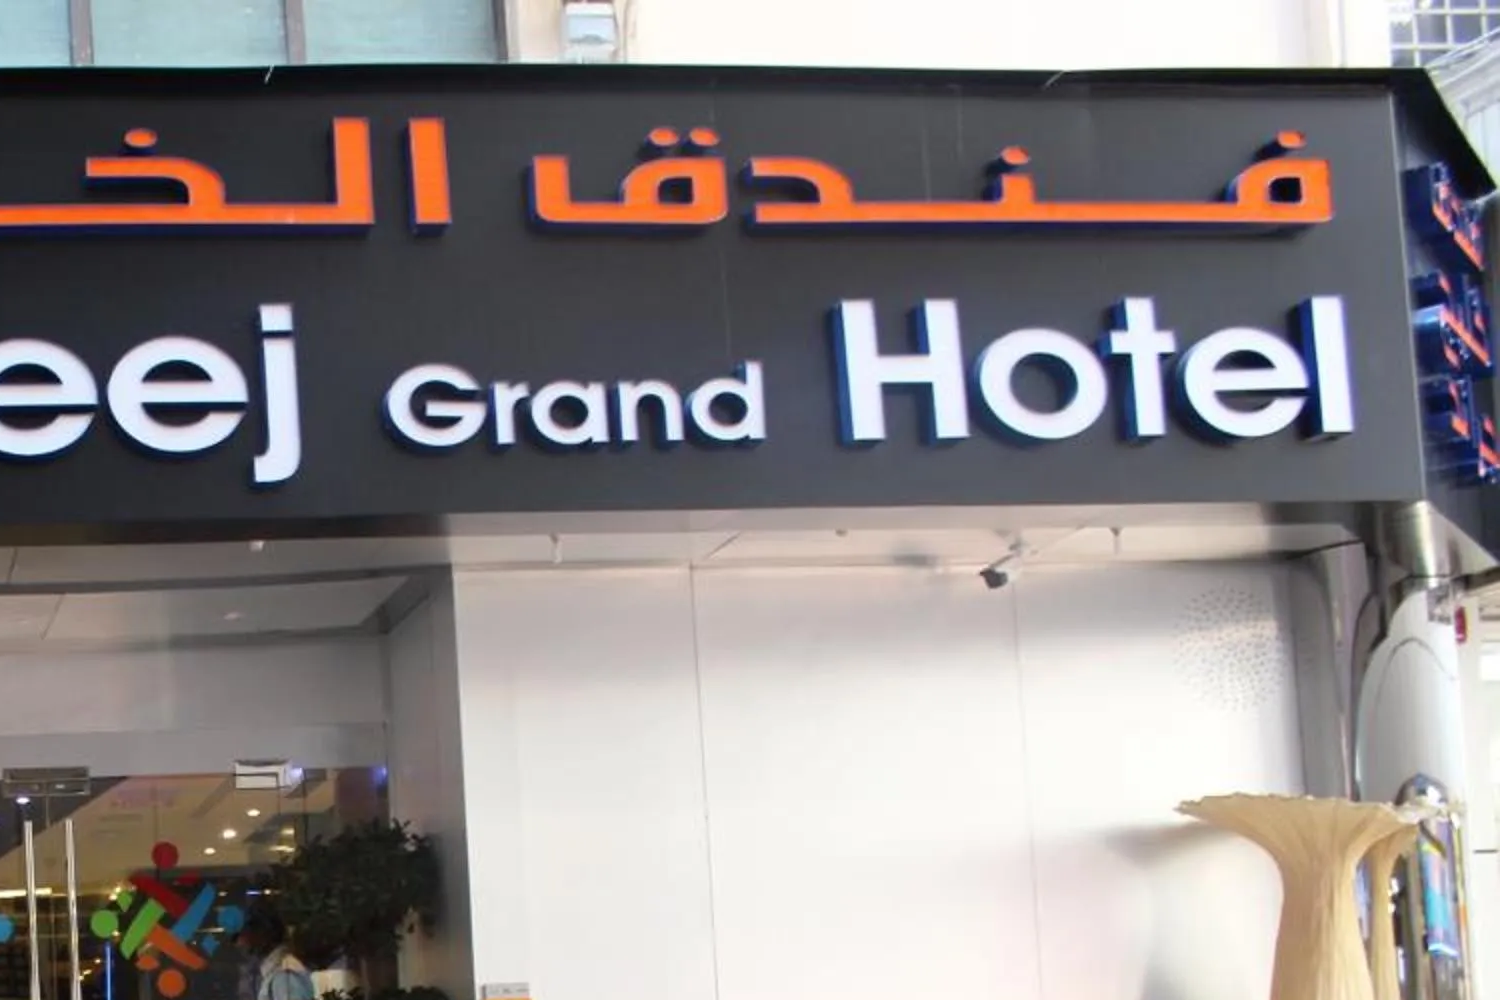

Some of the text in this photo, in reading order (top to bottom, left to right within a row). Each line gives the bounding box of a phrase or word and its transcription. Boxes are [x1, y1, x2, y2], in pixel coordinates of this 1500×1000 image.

[528, 127, 1334, 224] فندق
[386, 360, 767, 447] Grand
[836, 295, 1355, 442] Hotel
